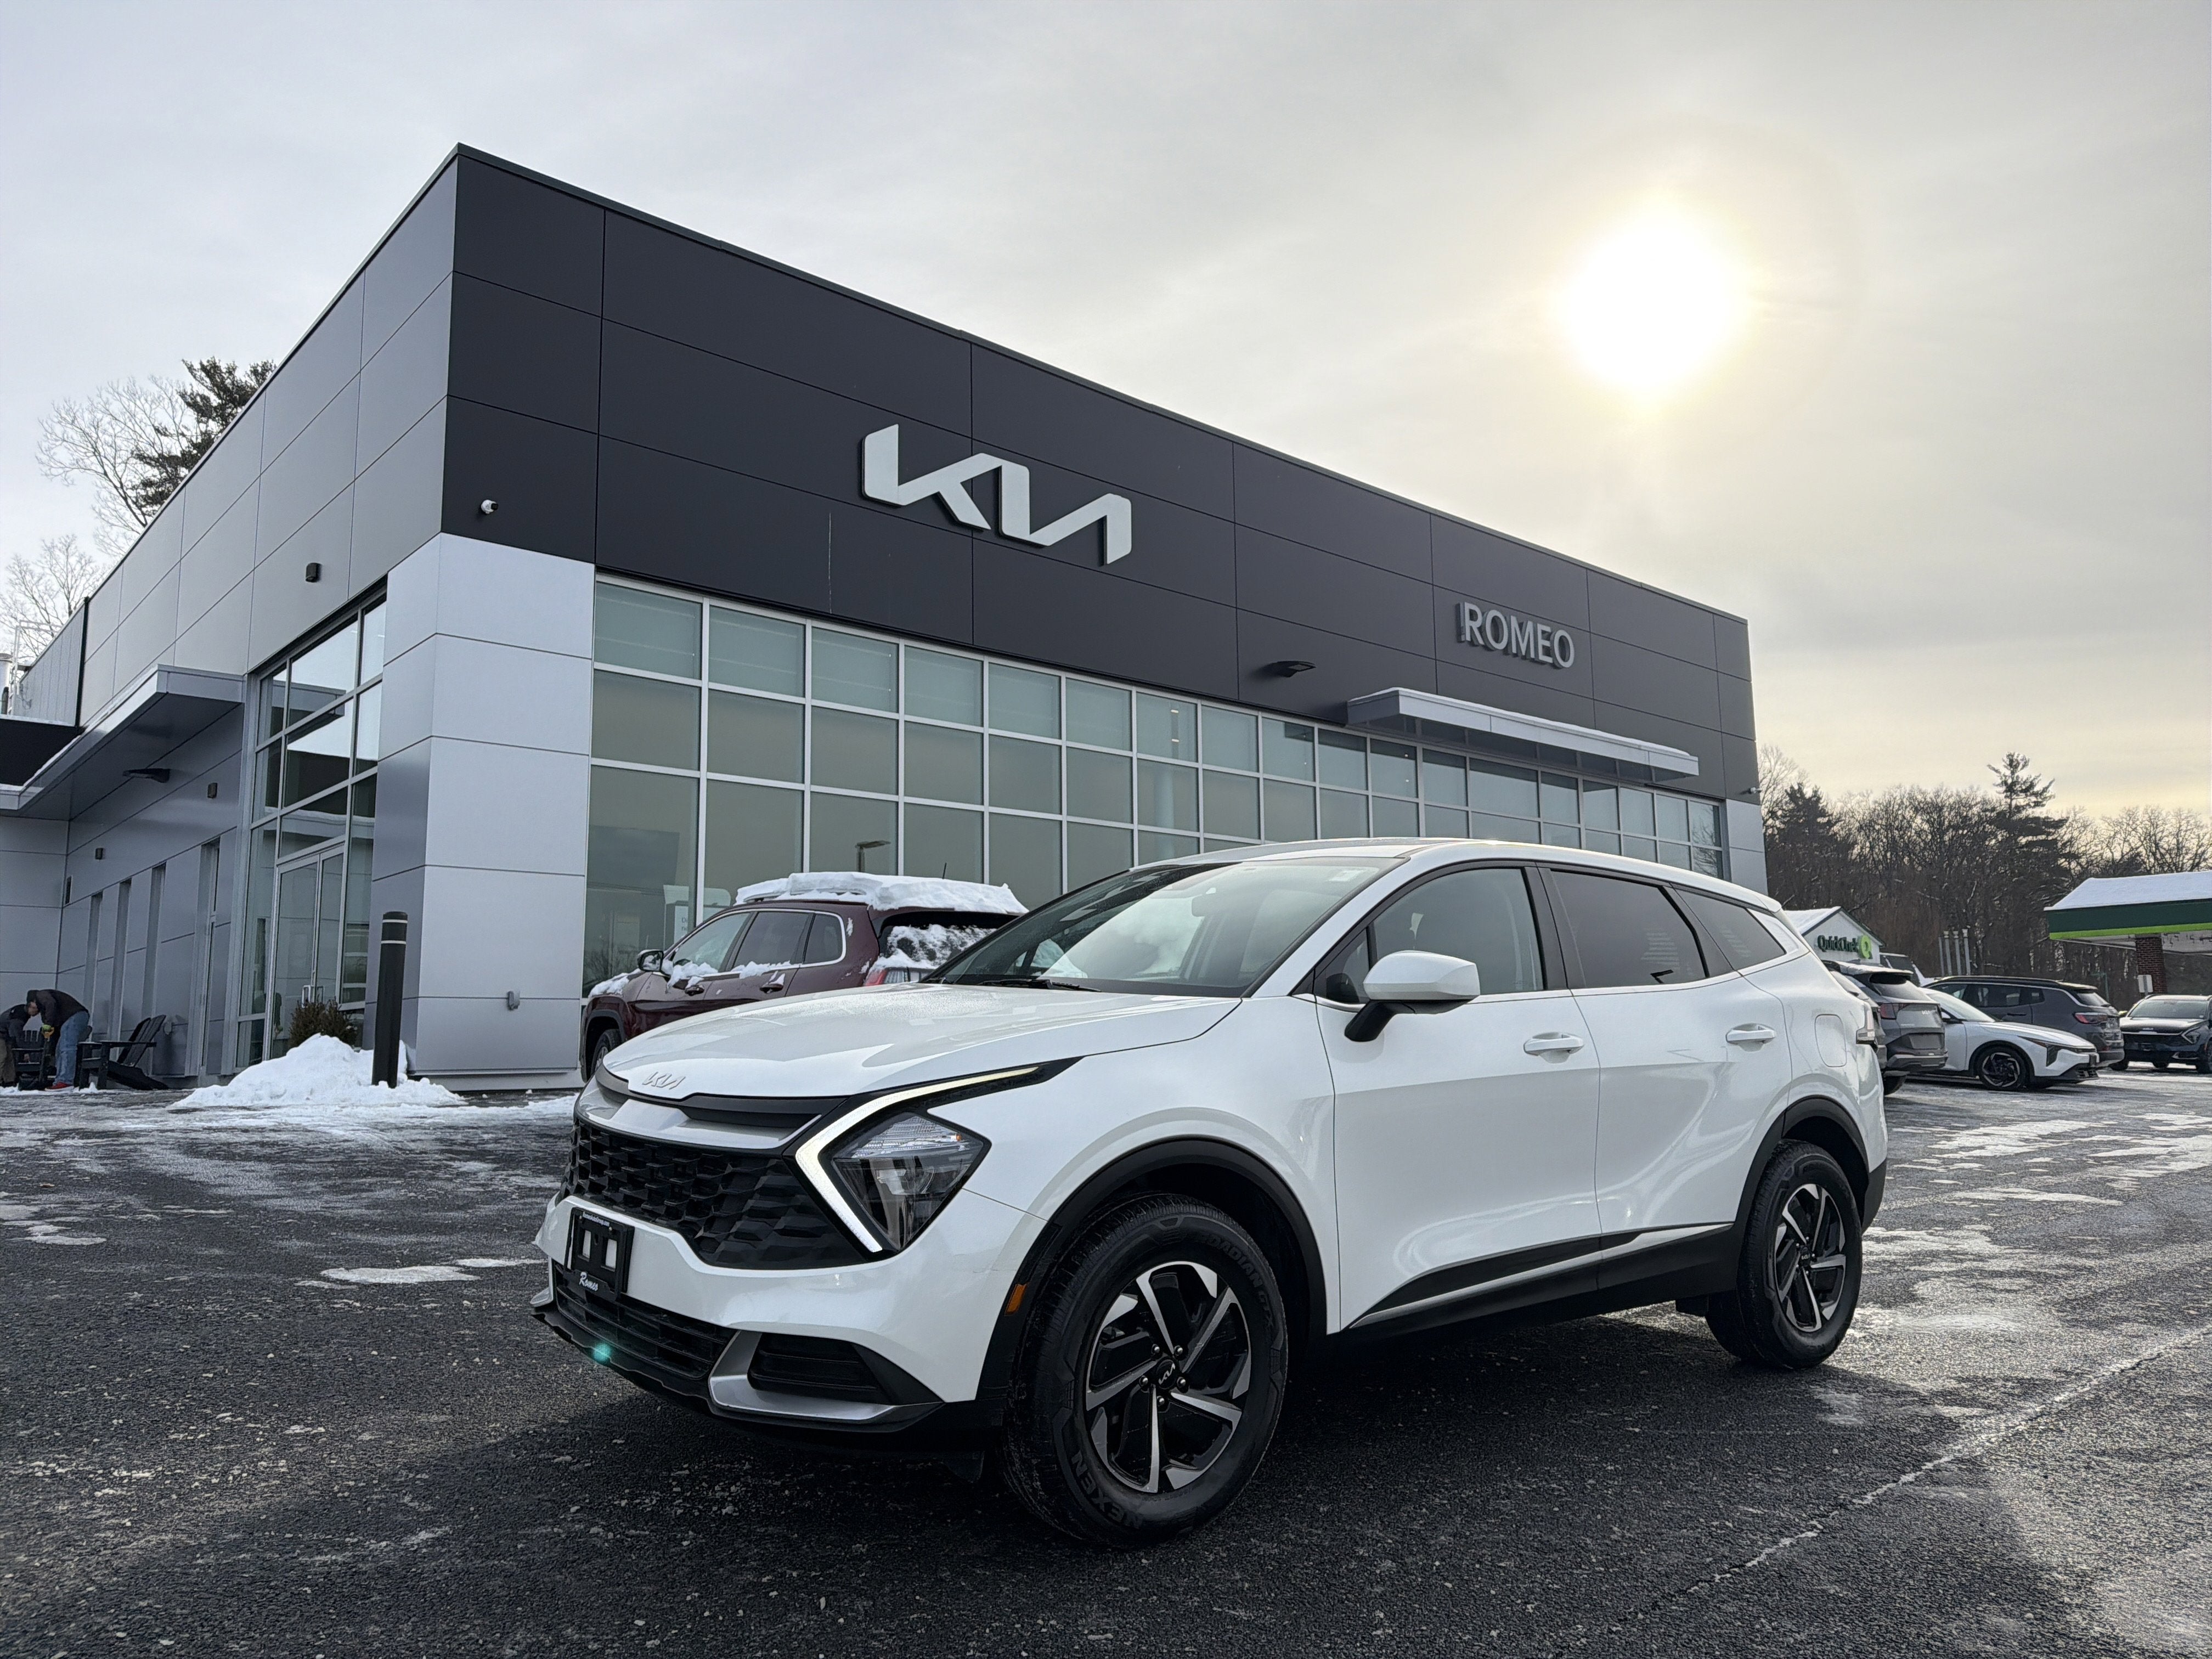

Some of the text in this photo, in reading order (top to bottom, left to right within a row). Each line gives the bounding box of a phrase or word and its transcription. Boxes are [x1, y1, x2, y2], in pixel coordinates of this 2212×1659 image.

[862, 424, 1132, 565] KIA
[1460, 601, 1575, 669] ROMEO
[641, 1071, 686, 1090] KIA
[1198, 1232, 1263, 1288] OADIAN
[1158, 1363, 1176, 1385] KIA
[1071, 1449, 1143, 1529] NEXEN
